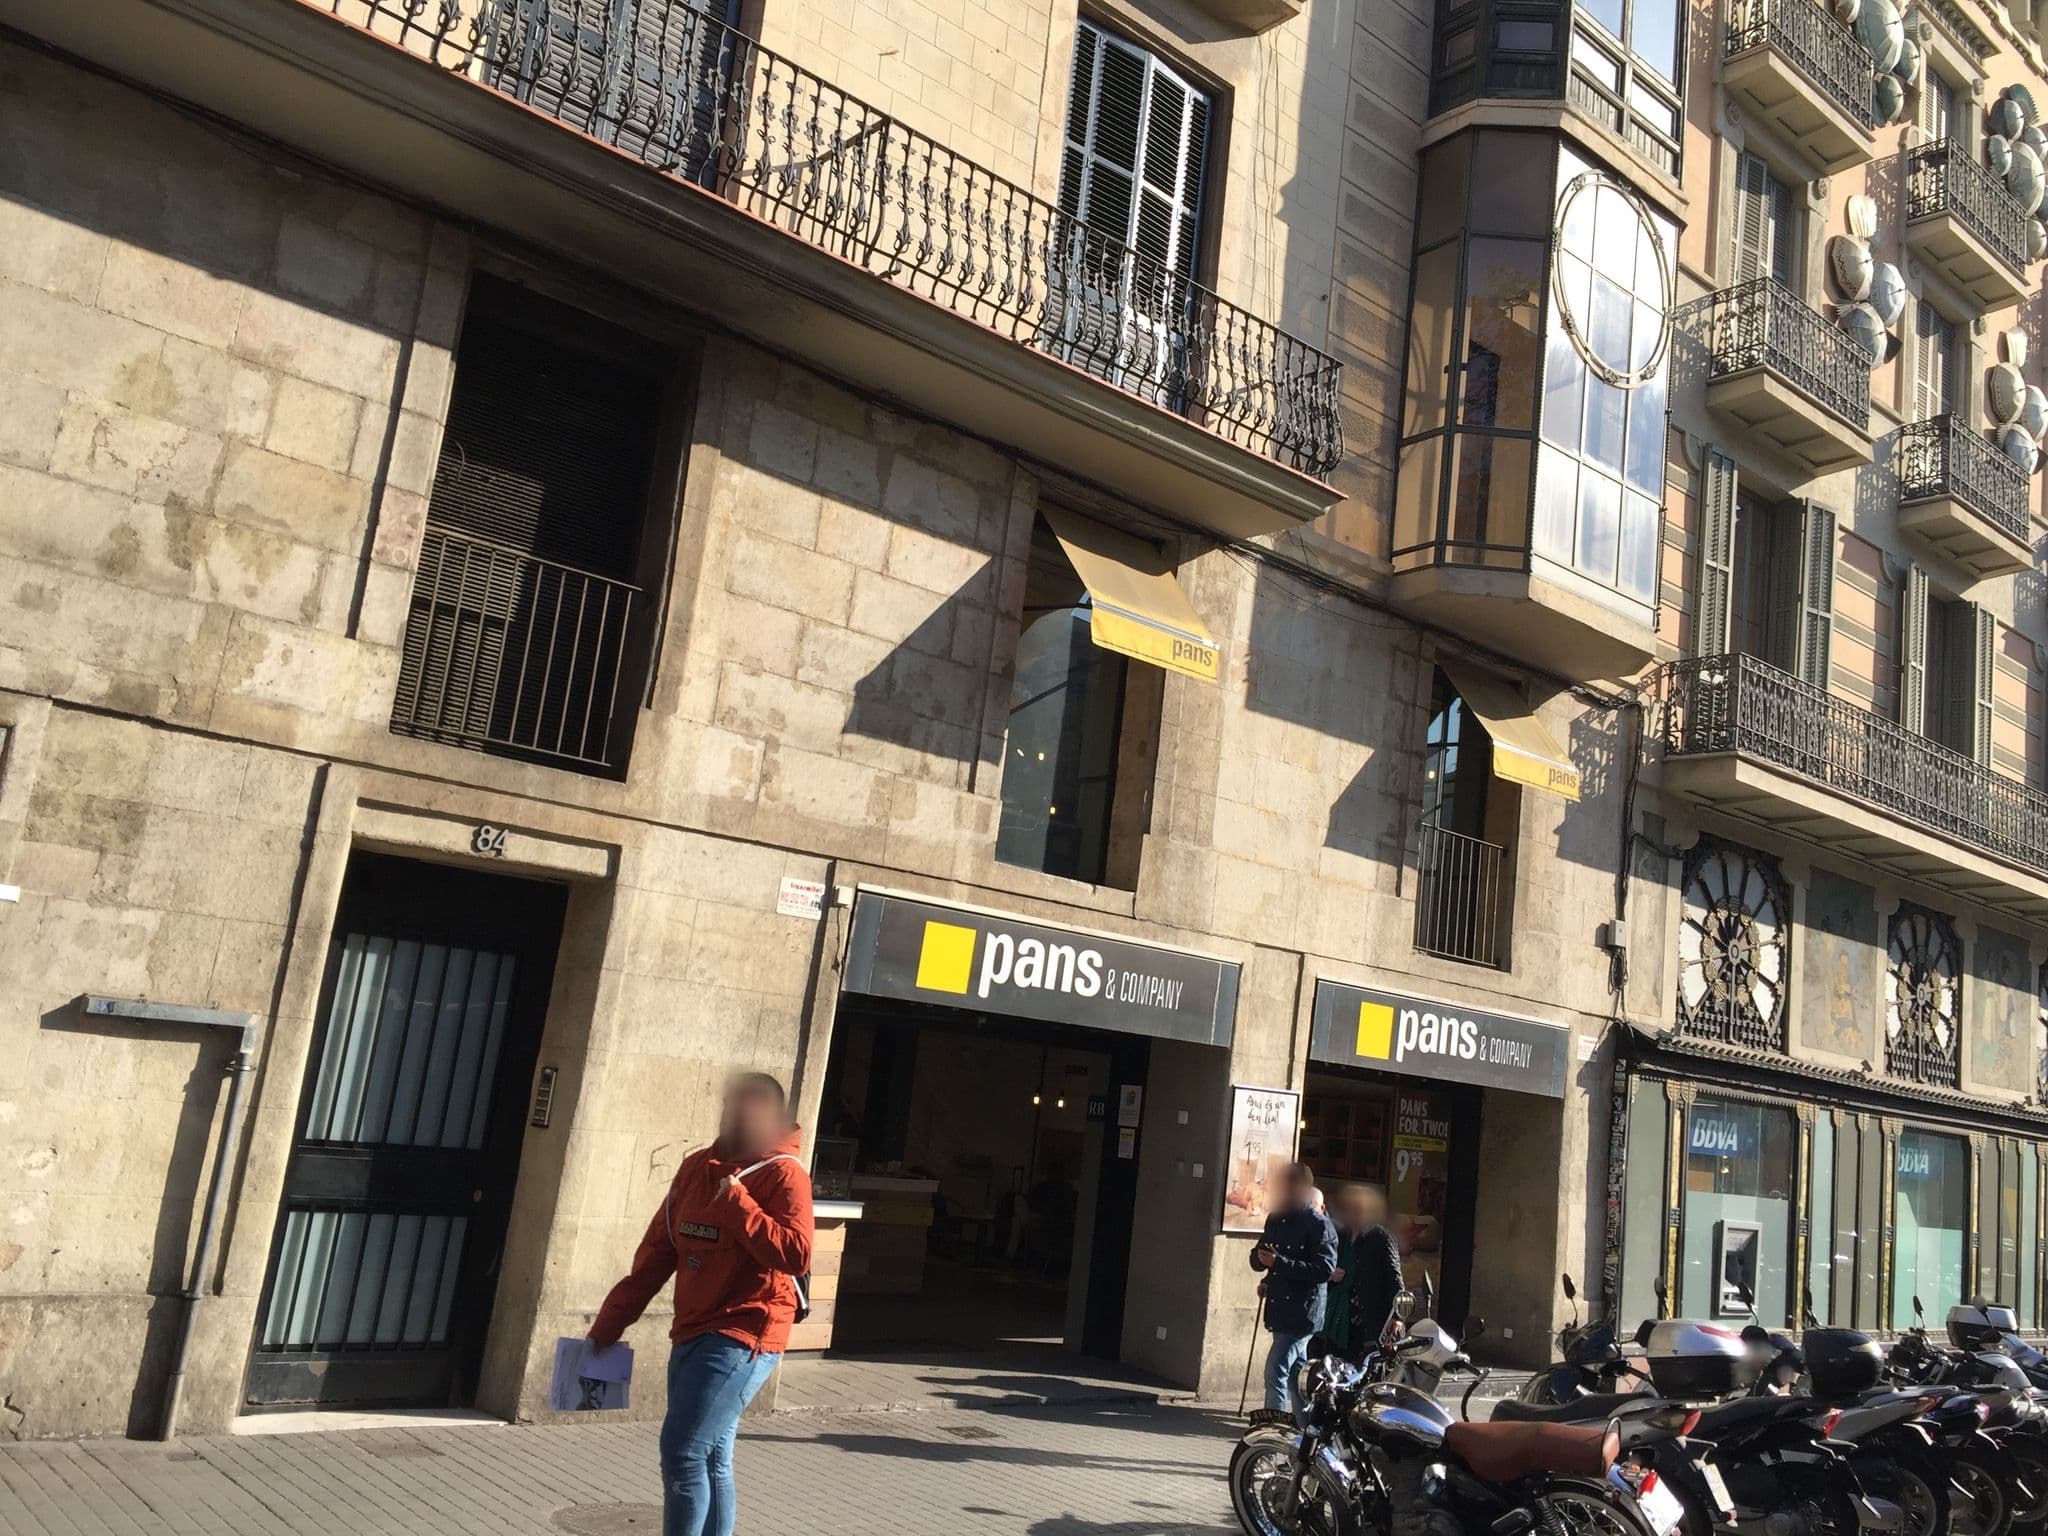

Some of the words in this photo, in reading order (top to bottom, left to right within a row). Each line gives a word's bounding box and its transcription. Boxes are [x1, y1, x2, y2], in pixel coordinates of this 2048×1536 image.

[1172, 638, 1212, 667] pans
[1548, 767, 1577, 788] pans
[476, 825, 510, 855] 84
[978, 932, 1104, 998] pans
[1105, 971, 1116, 1001] &
[1119, 972, 1184, 1010] COMPANY
[1395, 1008, 1479, 1063] pans
[1479, 1036, 1488, 1061] &
[1489, 1037, 1533, 1069] COMPANY
[1399, 1098, 1428, 1117] PANS
[1398, 1116, 1419, 1134] FOR
[1692, 1118, 1738, 1151] BBVA
